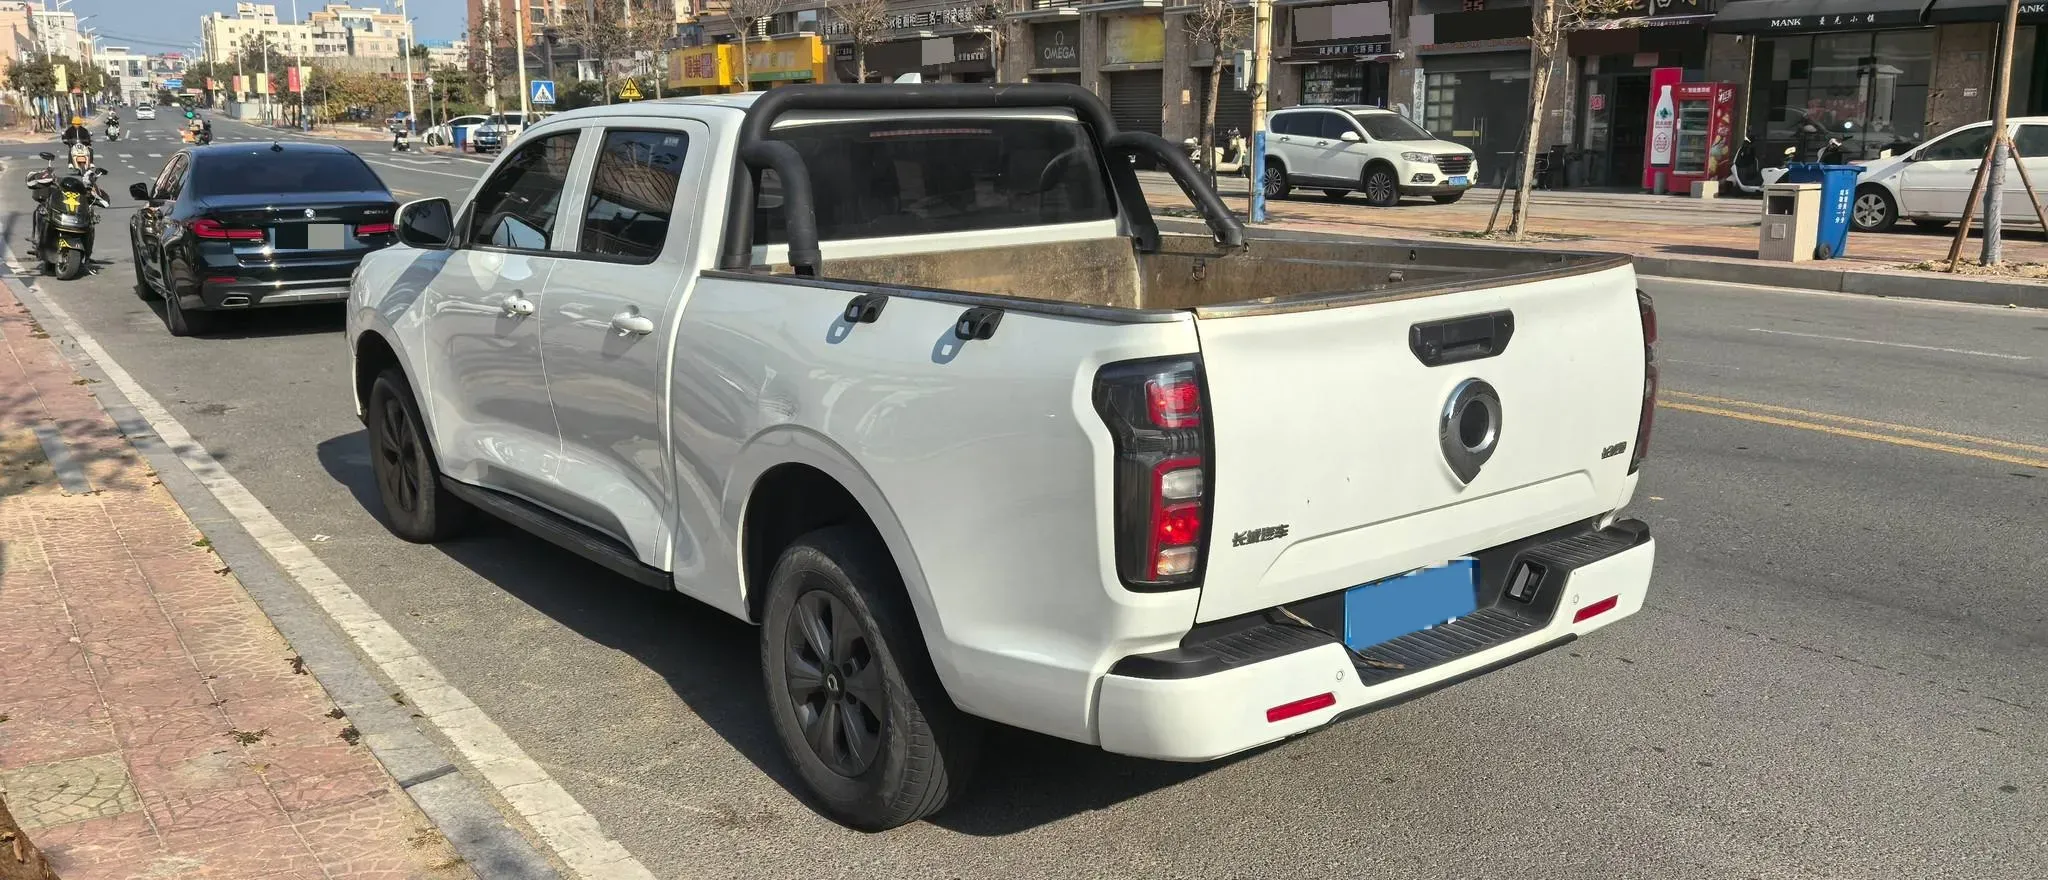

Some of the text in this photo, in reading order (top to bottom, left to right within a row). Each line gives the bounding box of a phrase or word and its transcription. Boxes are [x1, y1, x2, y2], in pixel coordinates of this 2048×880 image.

[2017, 3, 2045, 14] ANK
[1771, 18, 1801, 28] MANK
[1044, 45, 1076, 60] OMEGA
[1232, 524, 1289, 547] 长城汽车
